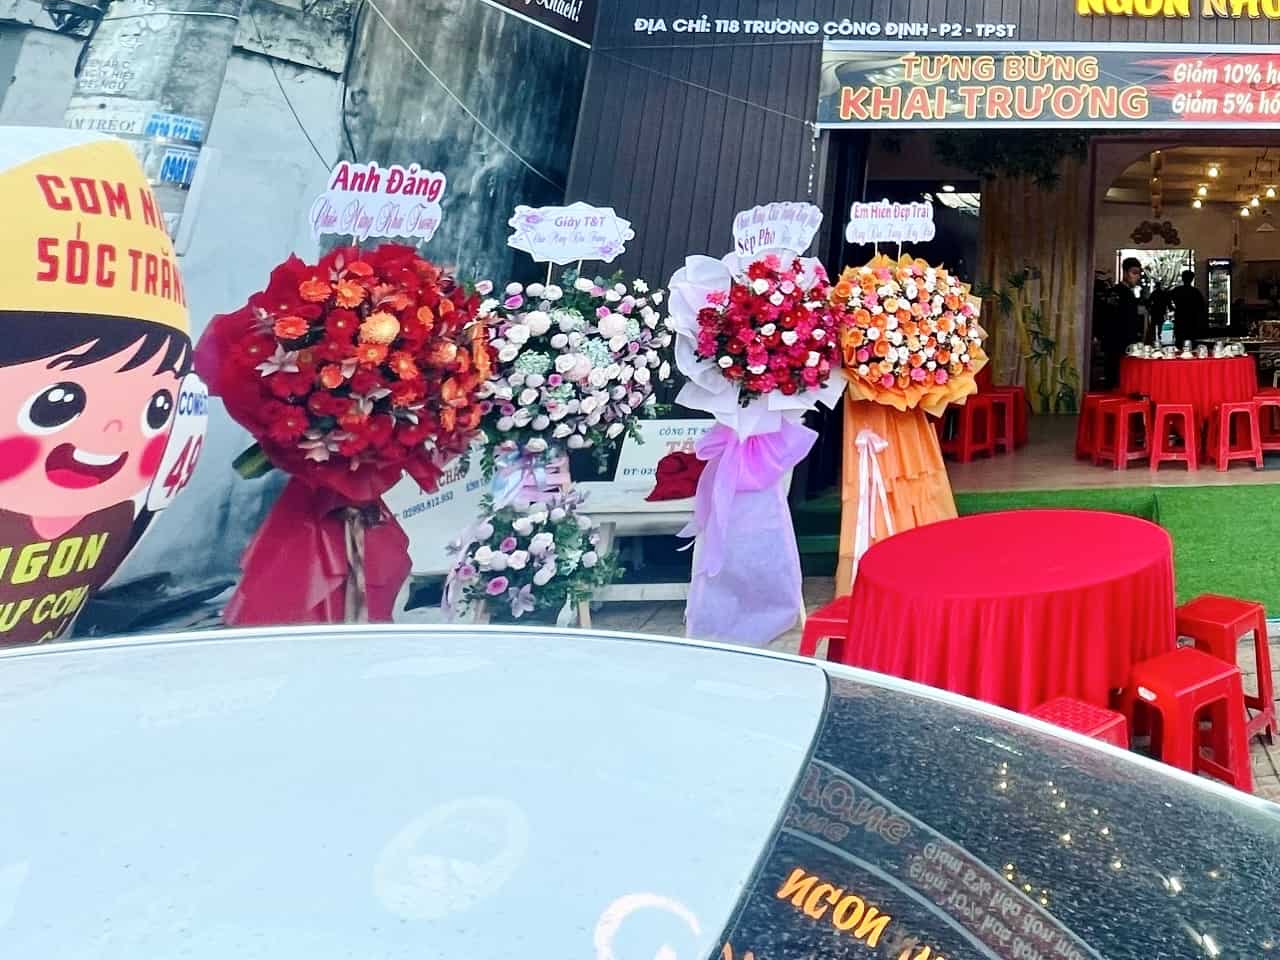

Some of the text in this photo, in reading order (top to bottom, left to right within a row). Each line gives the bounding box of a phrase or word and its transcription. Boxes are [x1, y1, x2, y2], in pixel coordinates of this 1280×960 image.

[633, 17, 668, 36] ĐỊA
[672, 13, 712, 34] CHỈ:
[714, 19, 740, 35] 118
[742, 19, 820, 36] TRƯƠNG
[823, 19, 881, 37] CÔNG
[975, 23, 1017, 38] TPST
[1173, 60, 1219, 84] Giảm
[1222, 63, 1262, 85] 10%
[838, 82, 1151, 121] KHAI TRƯƠNG
[1172, 90, 1218, 114] Giảm
[1222, 93, 1255, 114] 5%
[331, 163, 381, 193] Anh
[36, 221, 117, 289] SÓC
